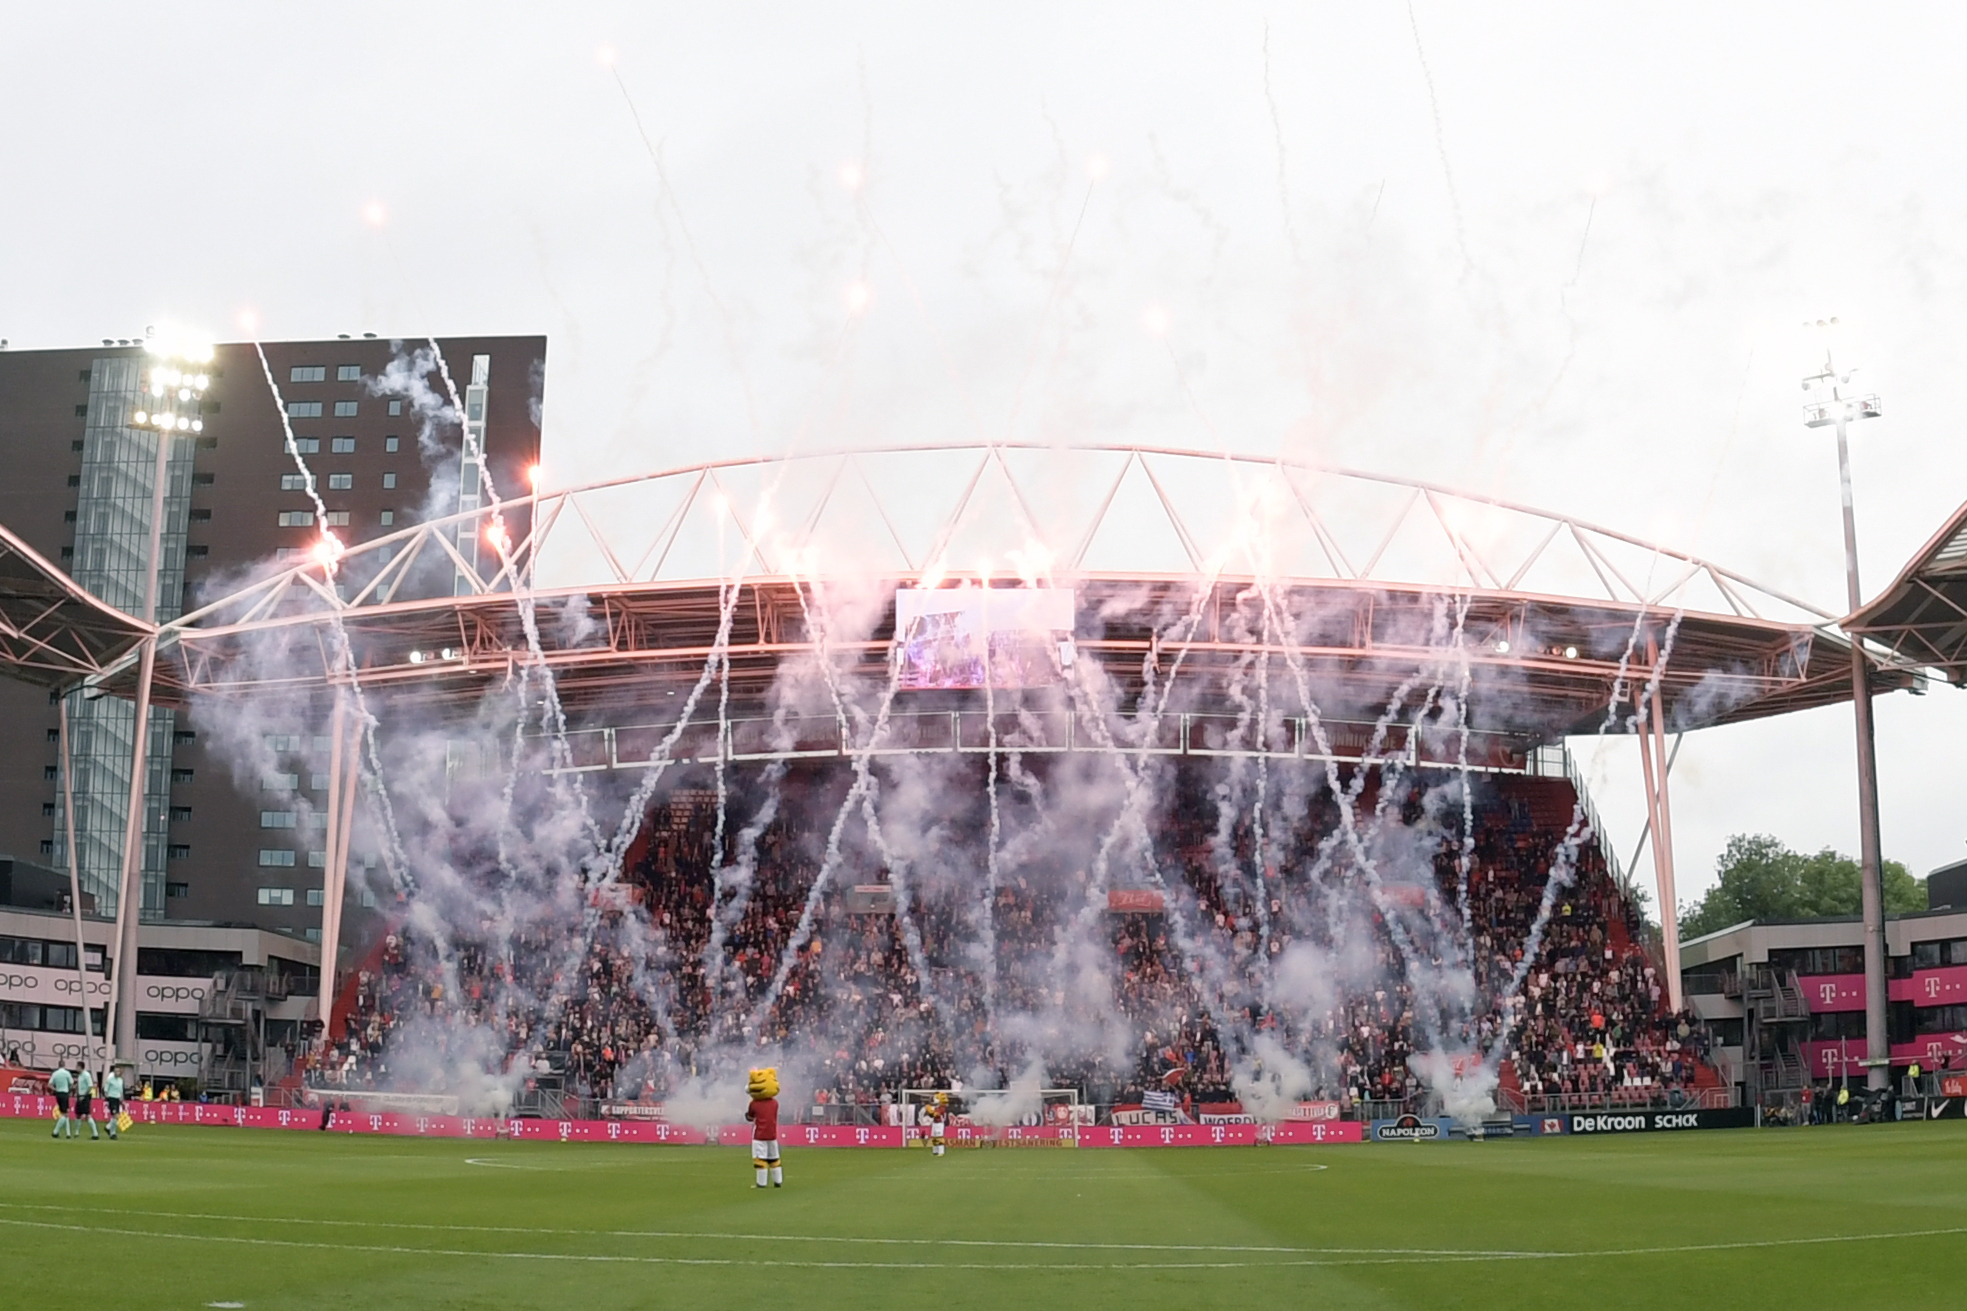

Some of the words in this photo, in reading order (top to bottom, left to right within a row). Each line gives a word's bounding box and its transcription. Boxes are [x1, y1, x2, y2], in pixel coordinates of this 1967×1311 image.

[146, 985, 205, 1003] oppo
[1115, 1110, 1178, 1125] LUCAS
[1382, 1127, 1435, 1137] NAPOLEON
